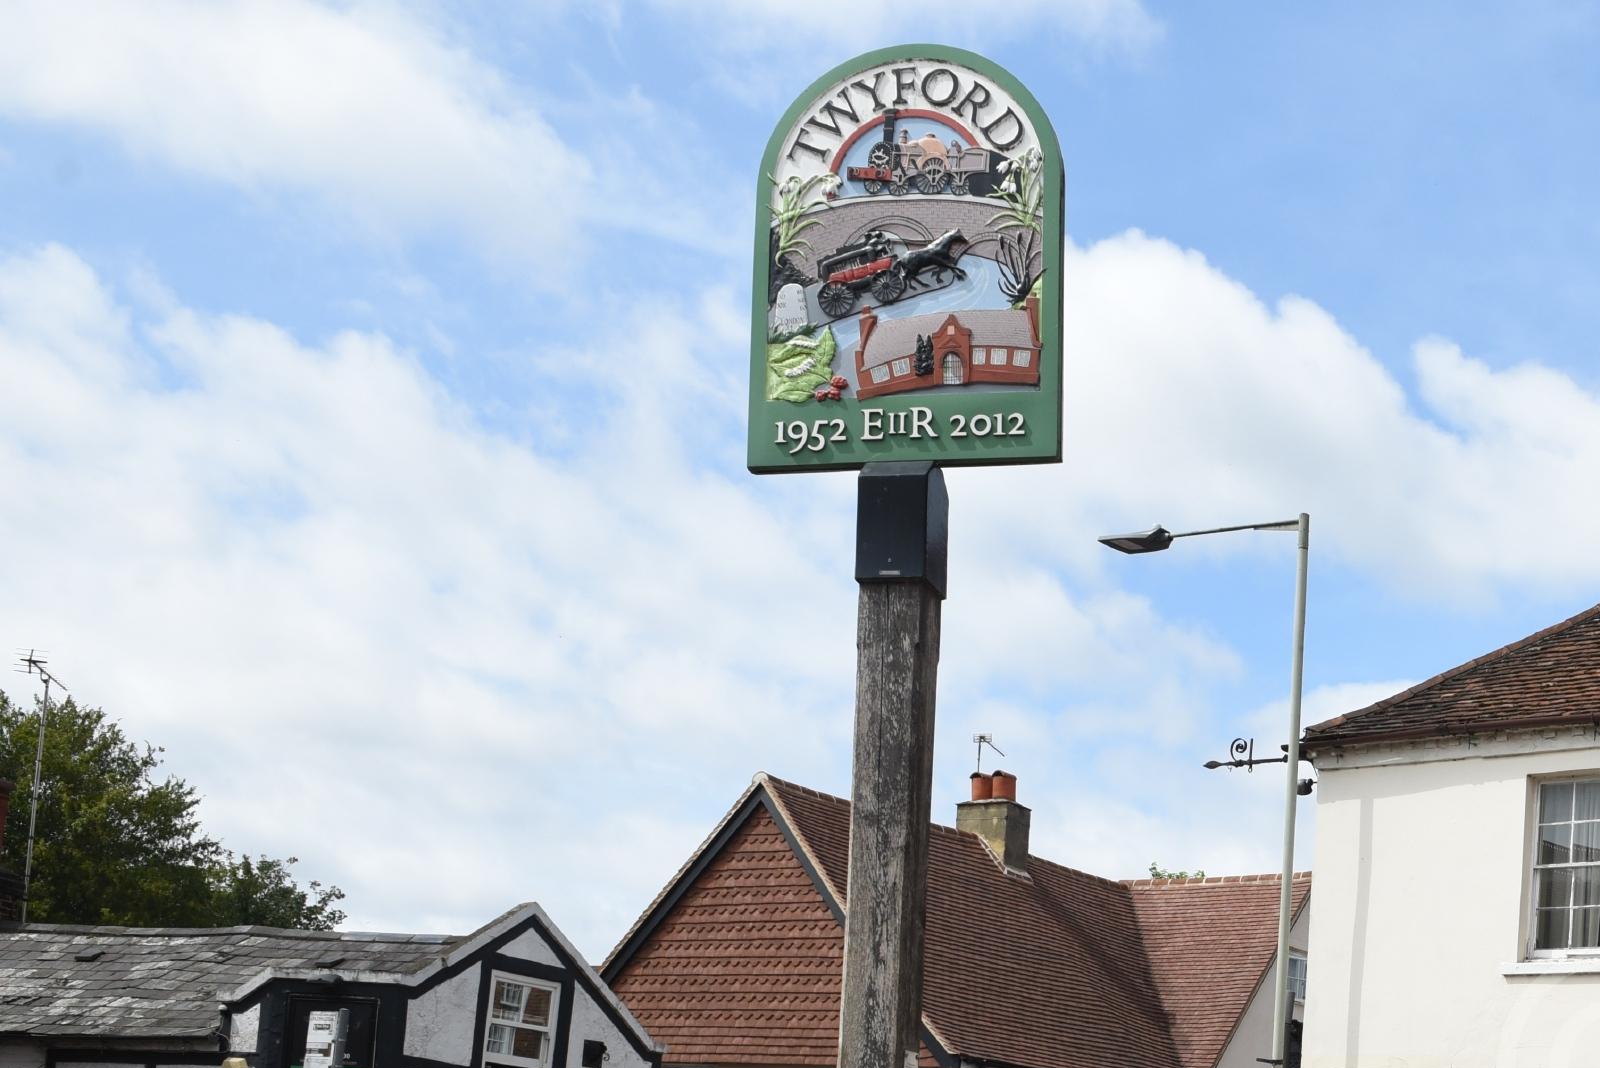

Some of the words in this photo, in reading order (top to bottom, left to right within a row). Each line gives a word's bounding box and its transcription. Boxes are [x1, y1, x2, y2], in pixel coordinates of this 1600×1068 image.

[785, 66, 1026, 163] TWYFORD
[774, 418, 847, 454] 1952
[950, 412, 1025, 437] 2012
